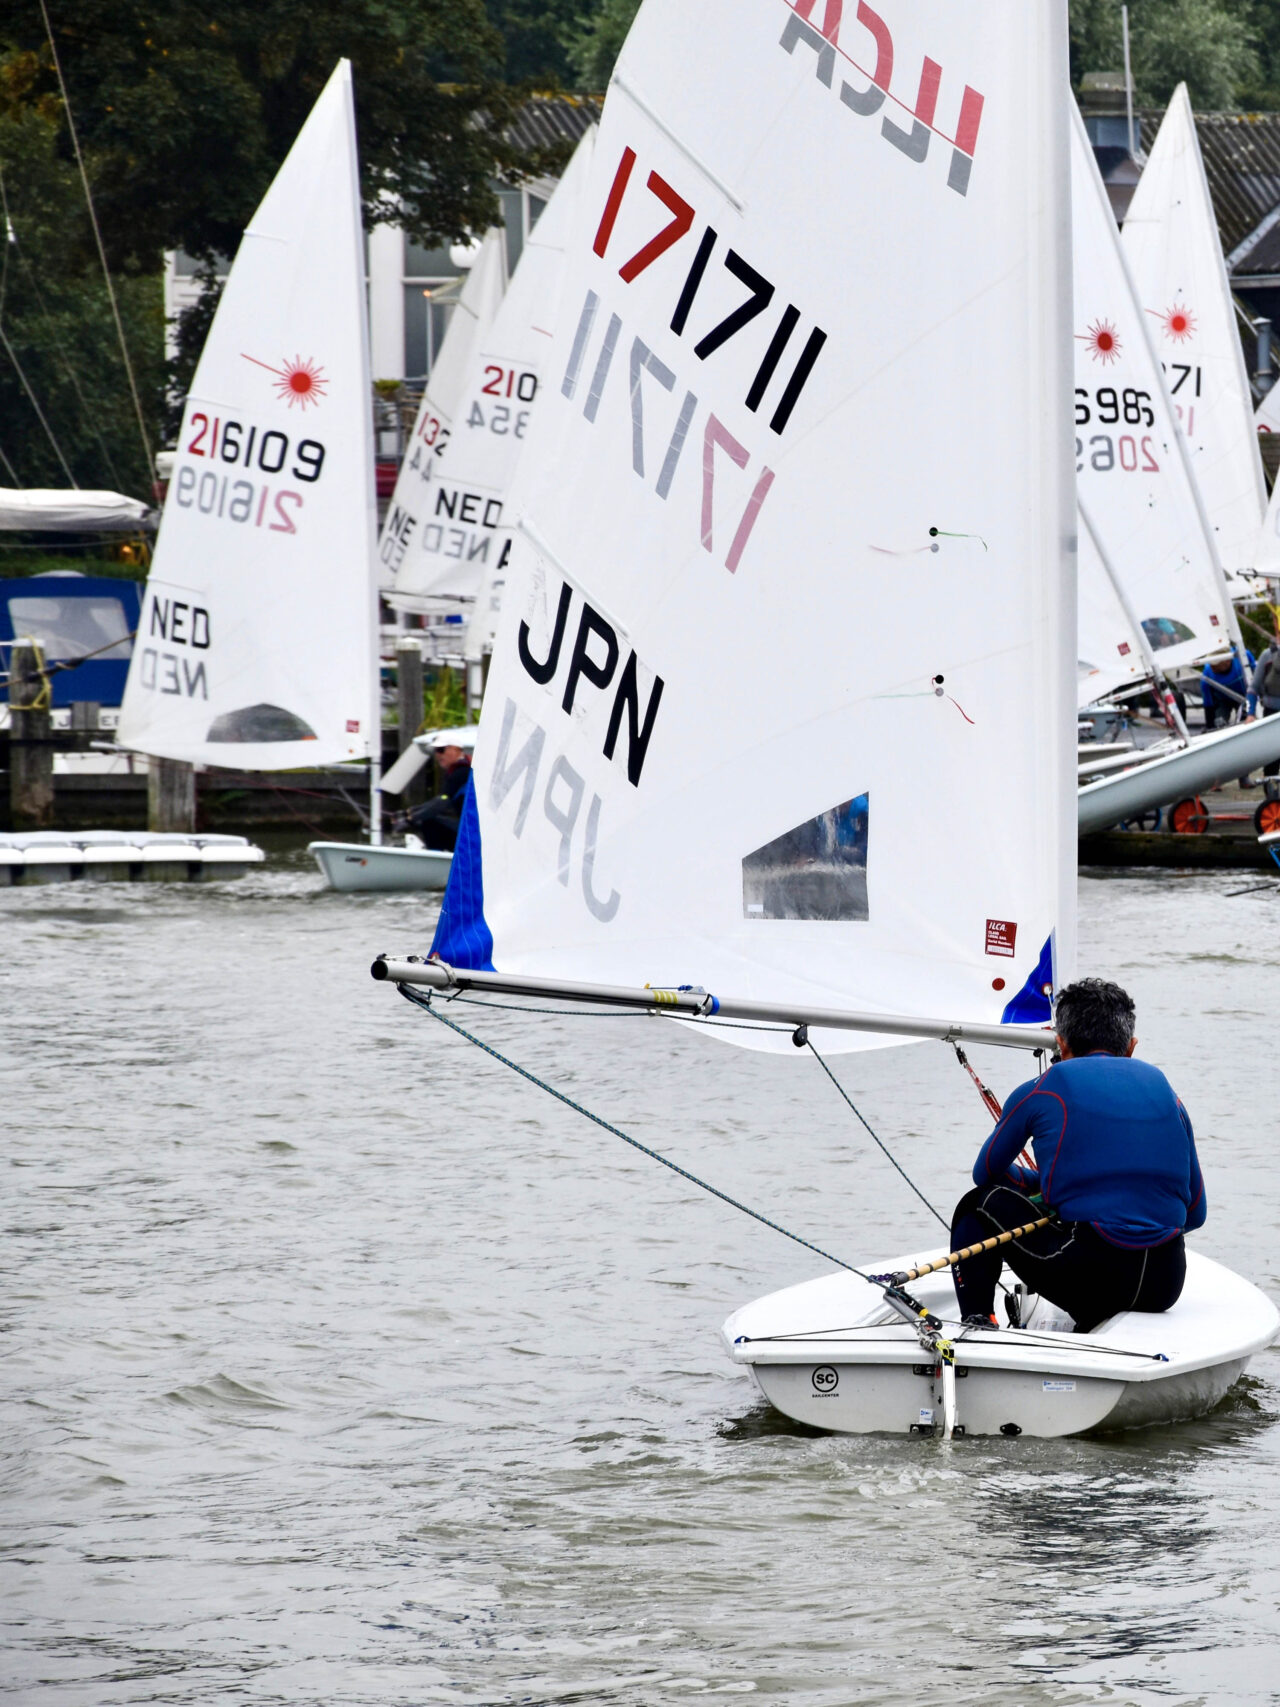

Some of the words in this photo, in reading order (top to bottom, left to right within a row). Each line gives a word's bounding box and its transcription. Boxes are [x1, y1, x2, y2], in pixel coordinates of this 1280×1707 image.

[593, 145, 828, 436] 171711
[481, 365, 538, 402] 210
[187, 412, 326, 483] 216109
[435, 487, 503, 529] NED
[150, 595, 211, 649] NED
[517, 581, 665, 788] JPN
[988, 921, 1007, 932] ILCA
[816, 1373, 834, 1384] SC
